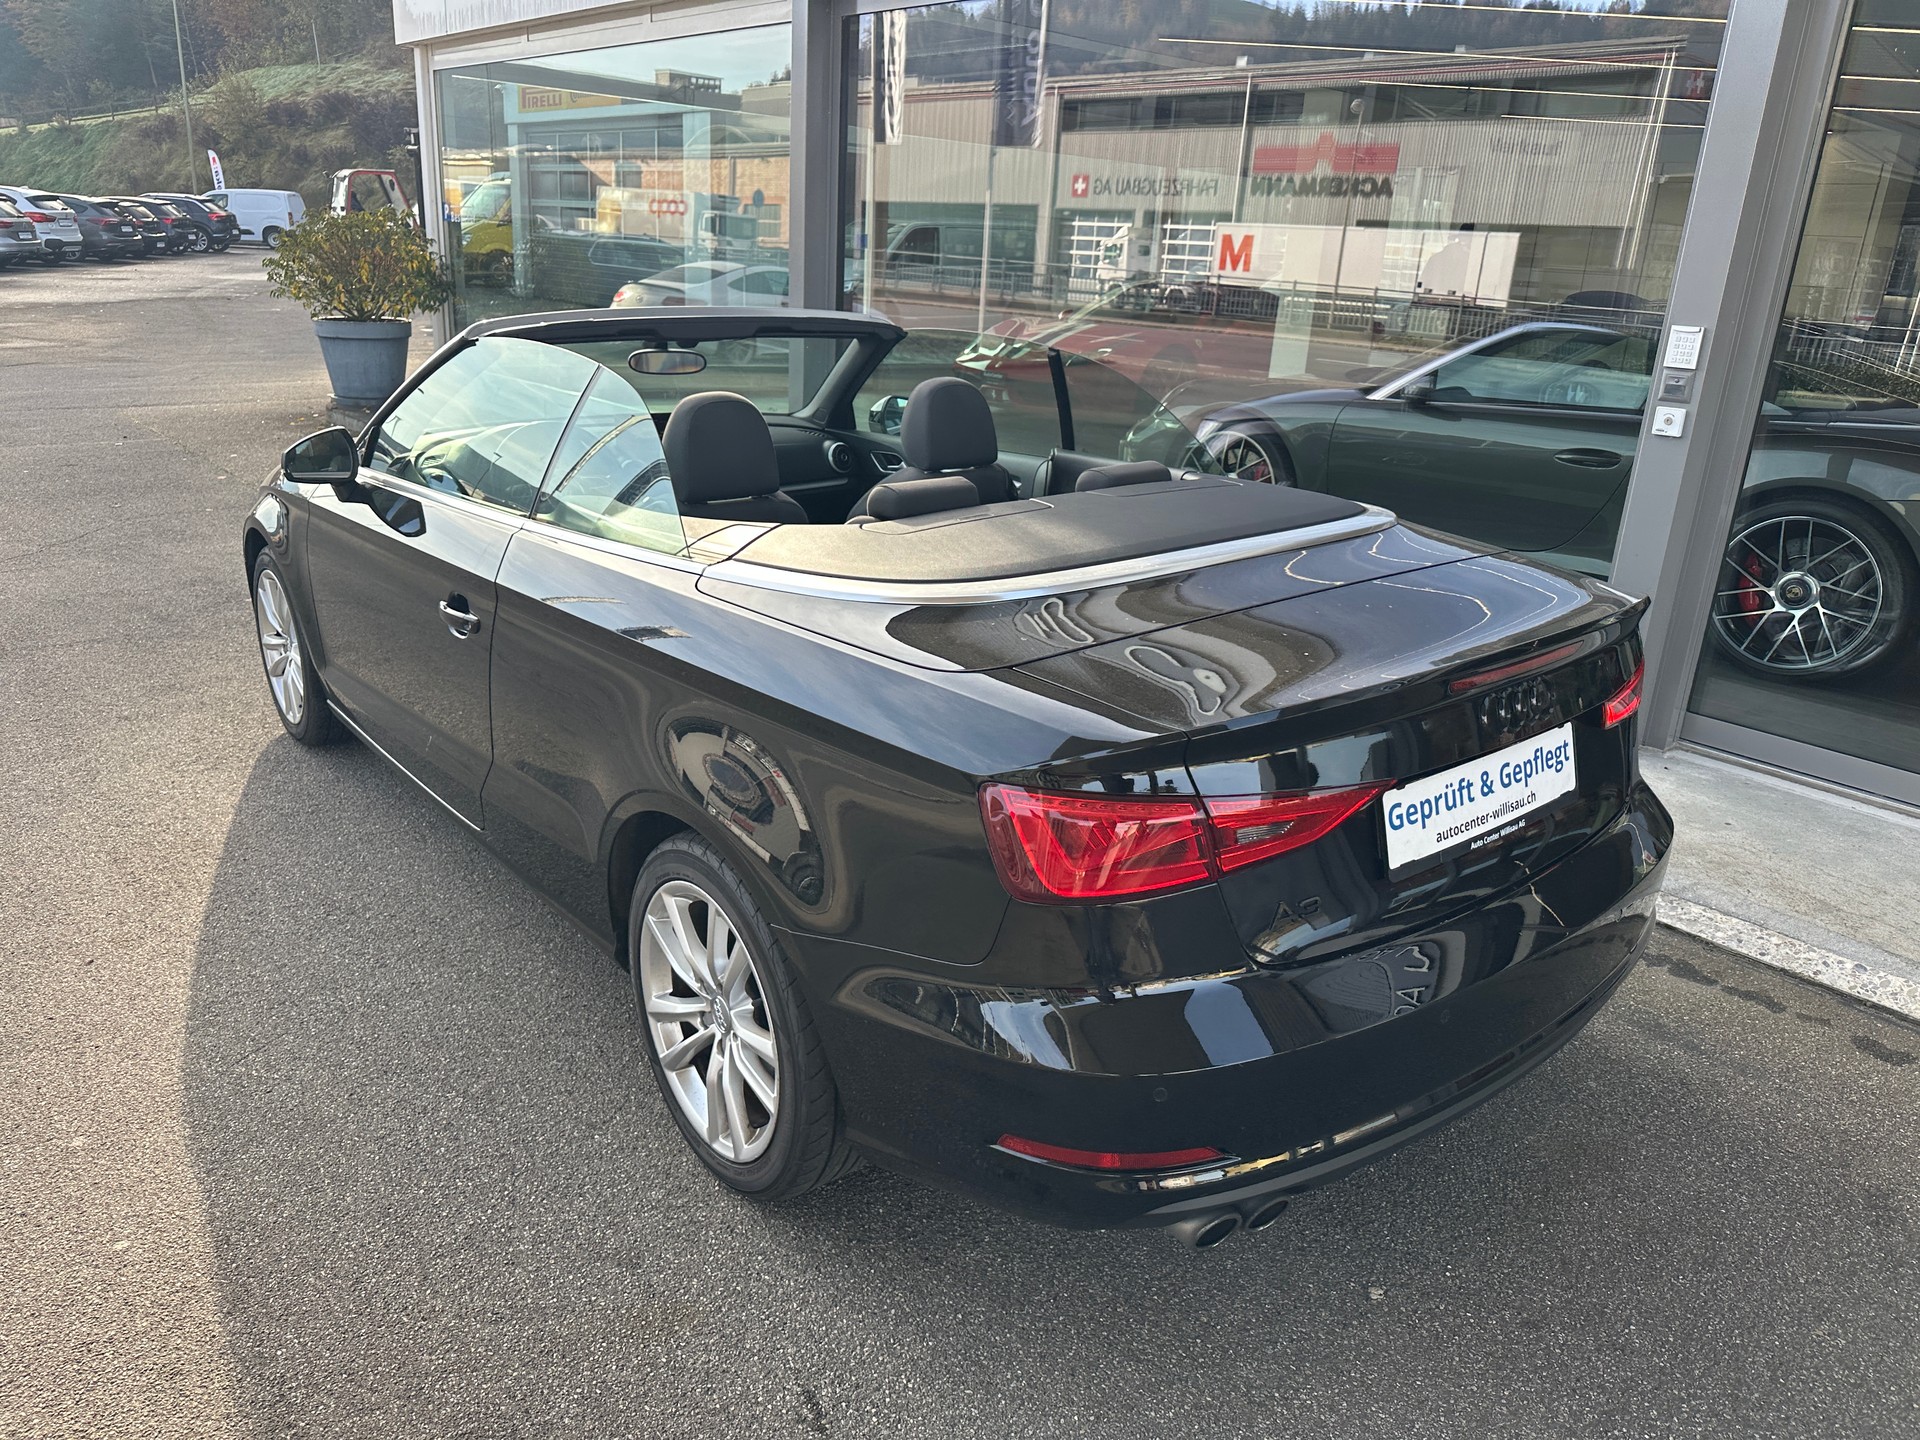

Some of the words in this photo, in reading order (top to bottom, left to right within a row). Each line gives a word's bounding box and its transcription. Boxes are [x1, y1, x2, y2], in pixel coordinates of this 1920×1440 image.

[521, 86, 562, 109] PIRELLI
[1389, 778, 1475, 831] Geprüft
[1480, 771, 1495, 797] &
[1500, 740, 1570, 788] Gepflegt
[1436, 791, 1537, 843] autocenter-willisau.ch
[1471, 839, 1483, 850] Auto
[1484, 832, 1500, 844] Center
[1500, 824, 1518, 837] Willisau
[1519, 819, 1526, 829] AG
